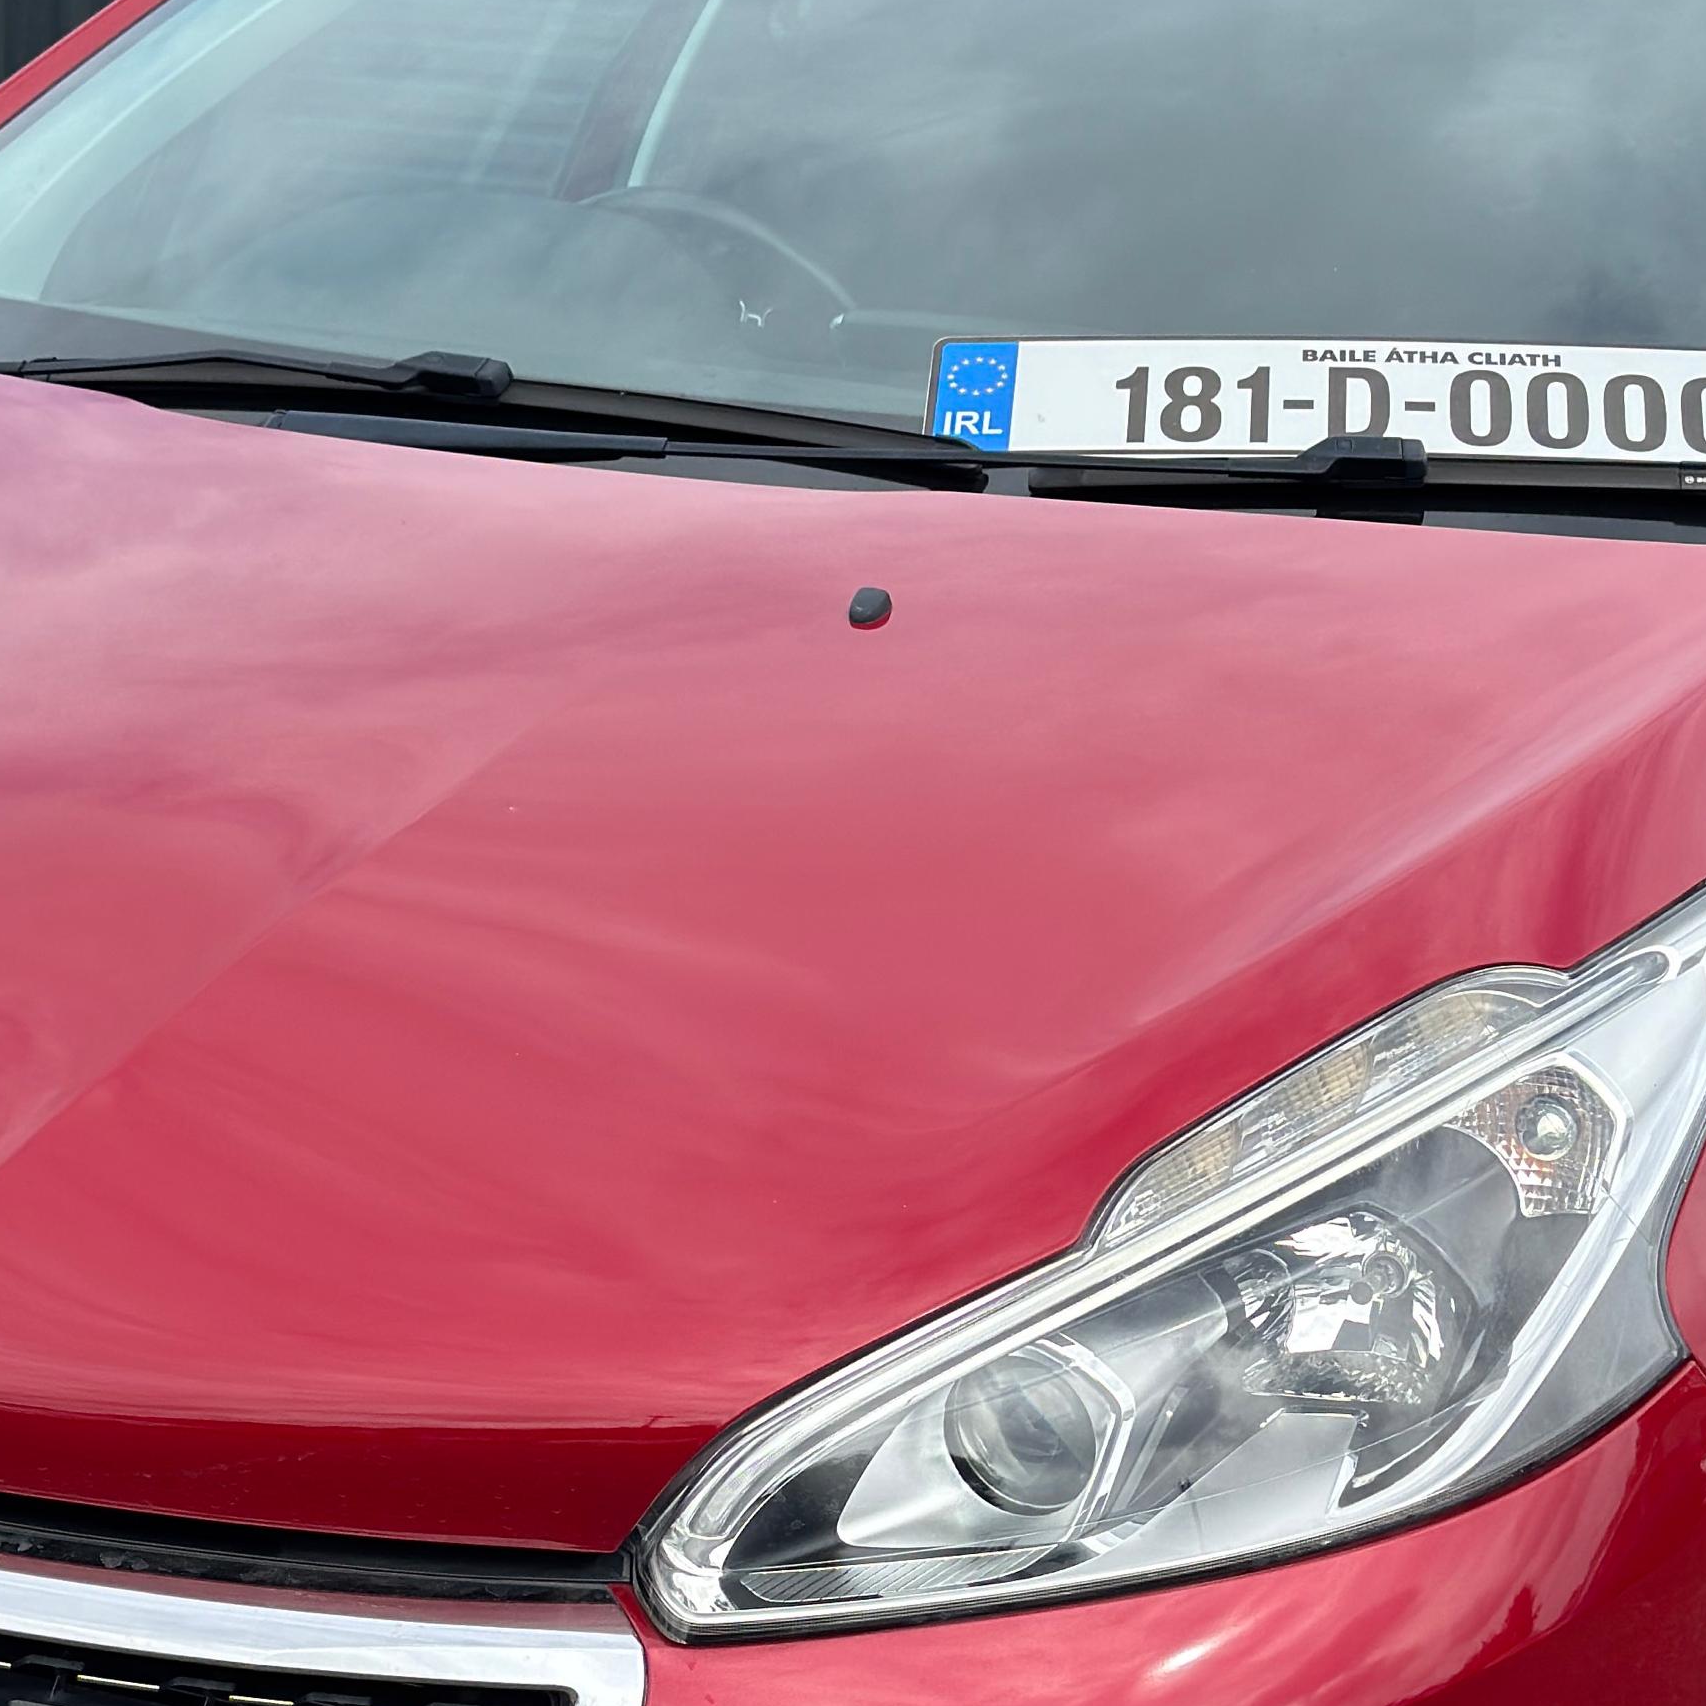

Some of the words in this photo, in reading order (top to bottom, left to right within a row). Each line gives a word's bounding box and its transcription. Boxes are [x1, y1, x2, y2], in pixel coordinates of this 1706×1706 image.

[1301, 348, 1377, 363] BAILE
[1384, 346, 1460, 365] ÁTHA
[1467, 350, 1562, 368] CLIATH
[943, 409, 1004, 436] IRL
